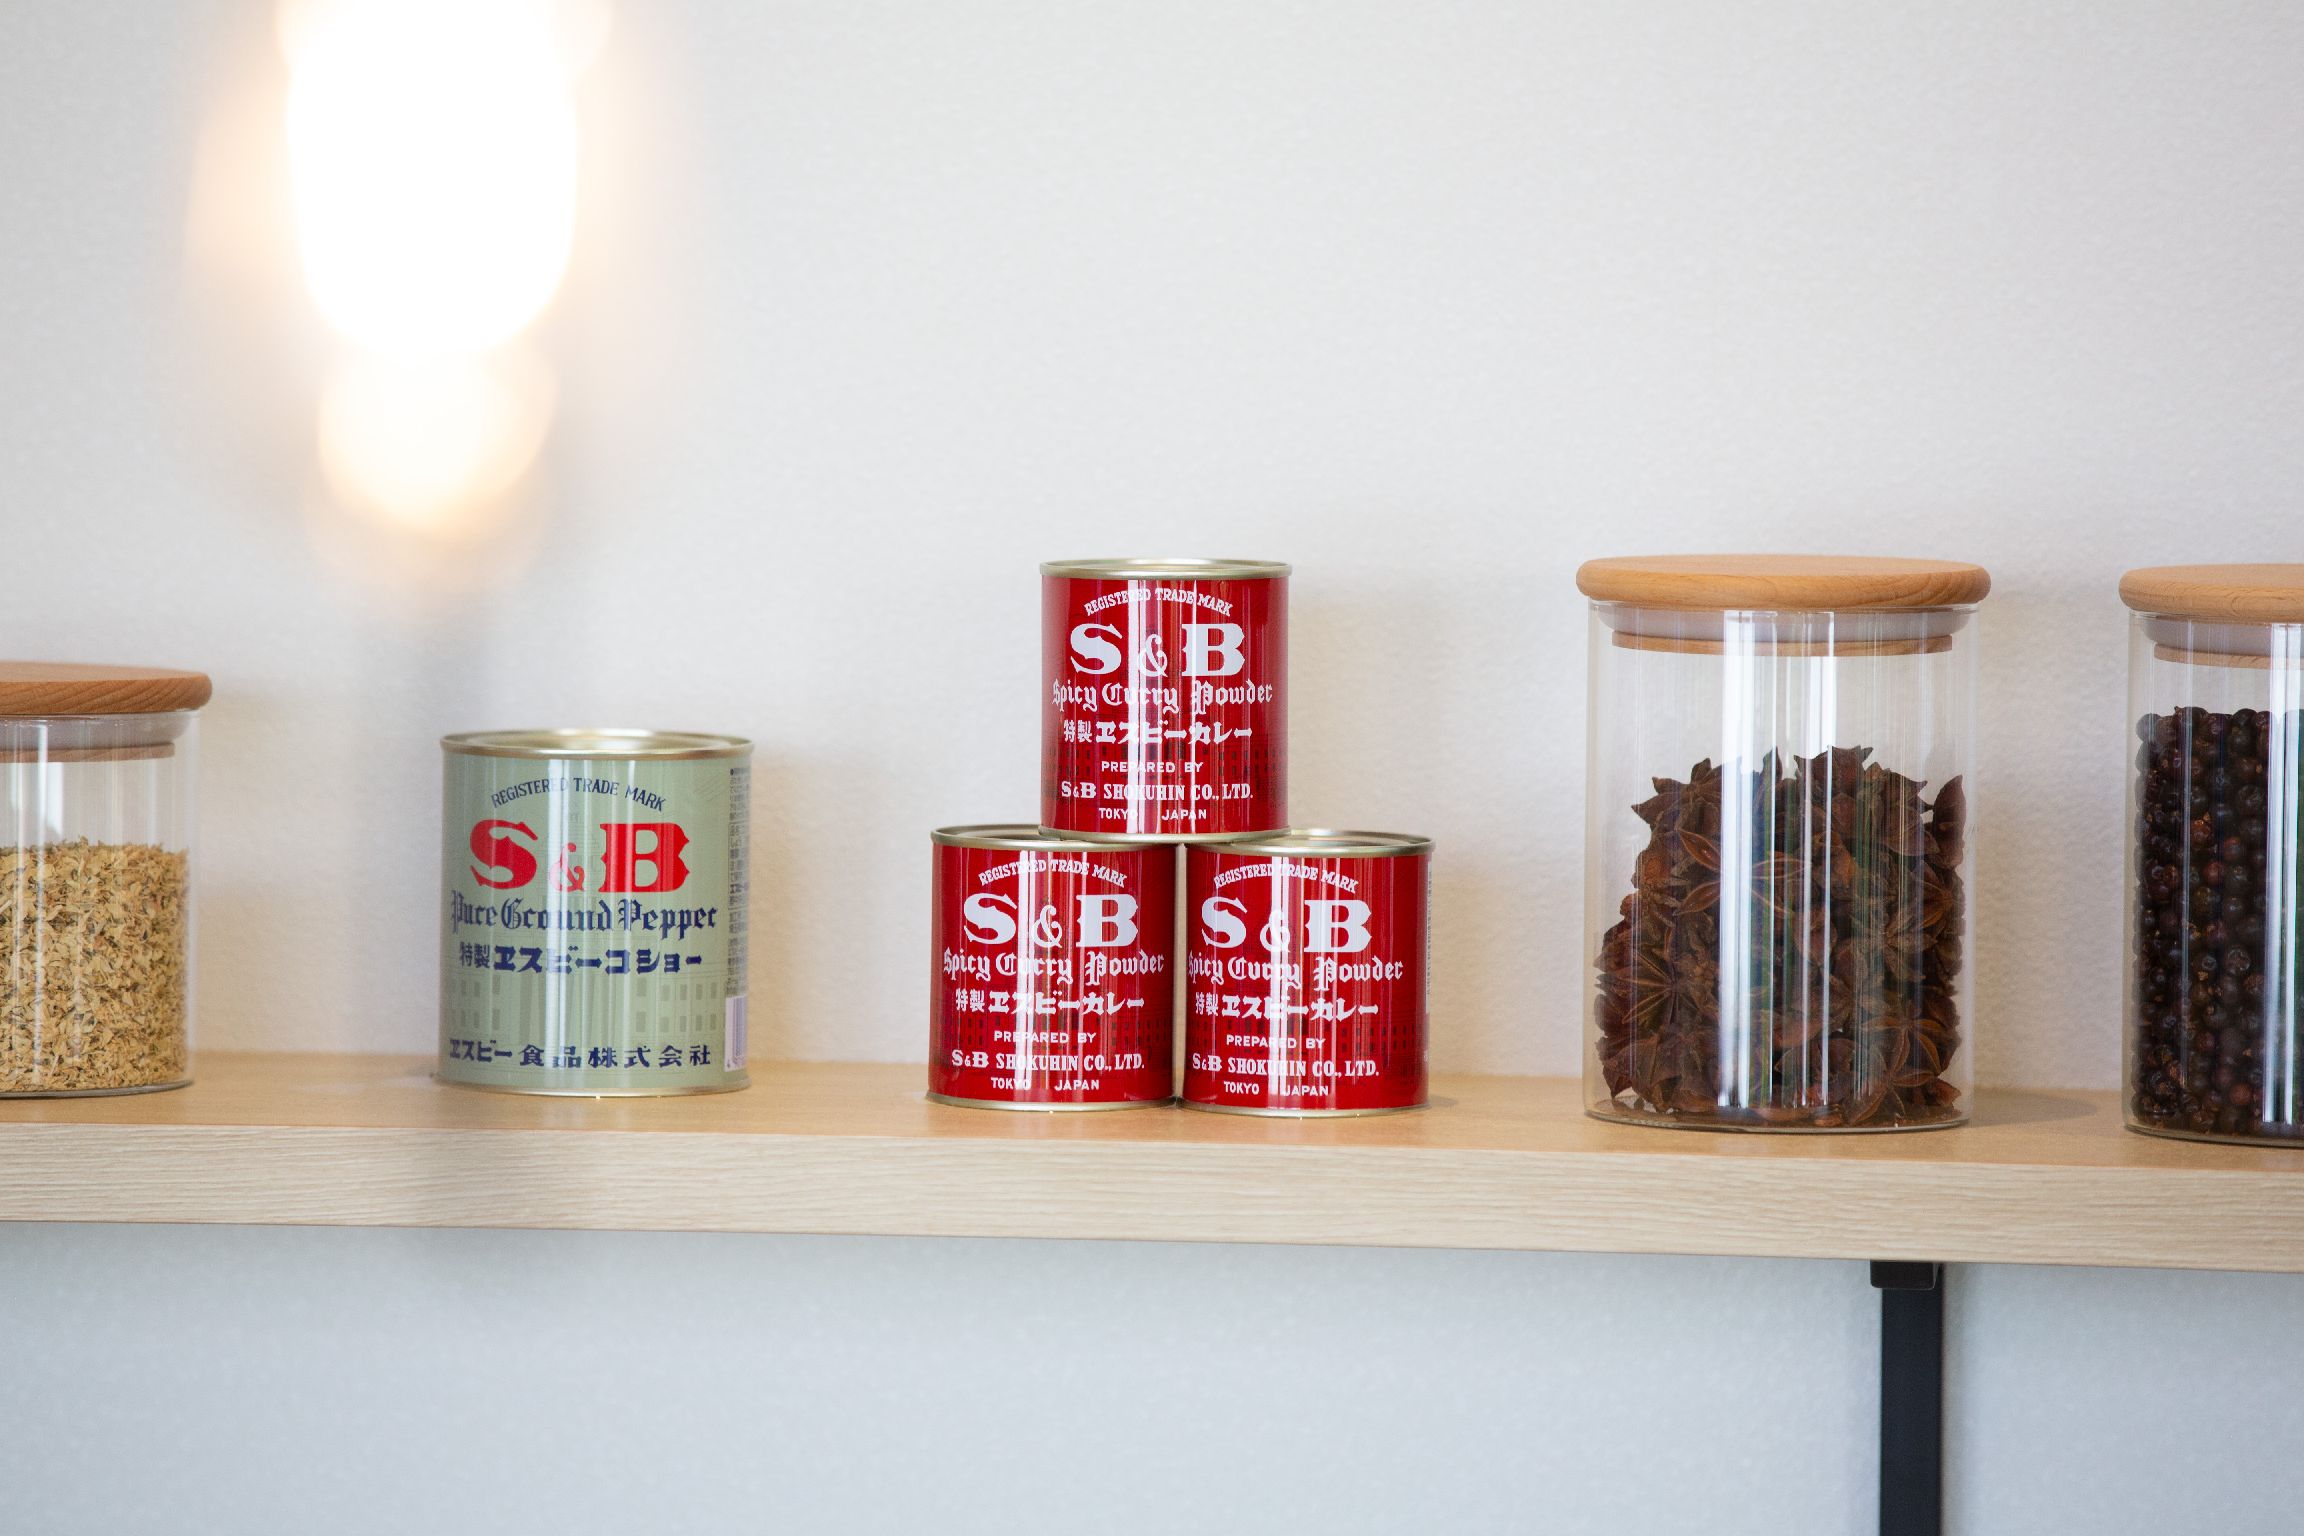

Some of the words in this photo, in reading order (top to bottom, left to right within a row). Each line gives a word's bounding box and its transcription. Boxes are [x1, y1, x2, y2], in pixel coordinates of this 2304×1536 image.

[1155, 588, 1196, 603] TRADE
[1197, 593, 1233, 617] MARK
[1052, 678, 1098, 712] Spicy
[1102, 682, 1180, 715] Curry
[1190, 678, 1273, 715] Powder
[1101, 761, 1175, 773] PREPARED
[1185, 761, 1203, 773] BY
[491, 777, 568, 809] REGISTERED
[573, 777, 620, 796] TRADE
[625, 785, 667, 812] MARK
[1061, 781, 1097, 799] S&B
[1103, 783, 1185, 800] SHOKUHIN
[1099, 807, 1138, 820] TOKYO
[1162, 808, 1207, 820] JAPAN
[1051, 859, 1090, 875] TRADE
[1092, 864, 1128, 888] MARK
[1213, 863, 1276, 889] REGISTERED
[1321, 869, 1359, 894] MARK
[451, 890, 497, 934] Pure
[501, 898, 612, 931] Ground
[617, 898, 718, 940] Pepper
[943, 947, 991, 982] Spicy
[996, 951, 1074, 985] Curry
[1084, 949, 1165, 986] Powder
[1188, 951, 1225, 986] Spicy
[1228, 956, 1302, 990] Curry
[1313, 955, 1403, 992] Powder
[994, 1030, 1069, 1043] PREPARED
[1078, 1032, 1097, 1044] BY
[1226, 1034, 1297, 1049] PREPARED
[1306, 1037, 1326, 1049] BY
[951, 1049, 990, 1068] S&B
[996, 1052, 1078, 1071] SHOKUHIN
[1192, 1053, 1222, 1072] S&B
[1228, 1057, 1306, 1077] SHOKUHIN
[991, 1077, 1031, 1090] TOKYO
[1054, 1079, 1100, 1091] JAPAN
[1224, 1081, 1260, 1095] TOKYO
[1282, 1085, 1329, 1097] JAPAN
